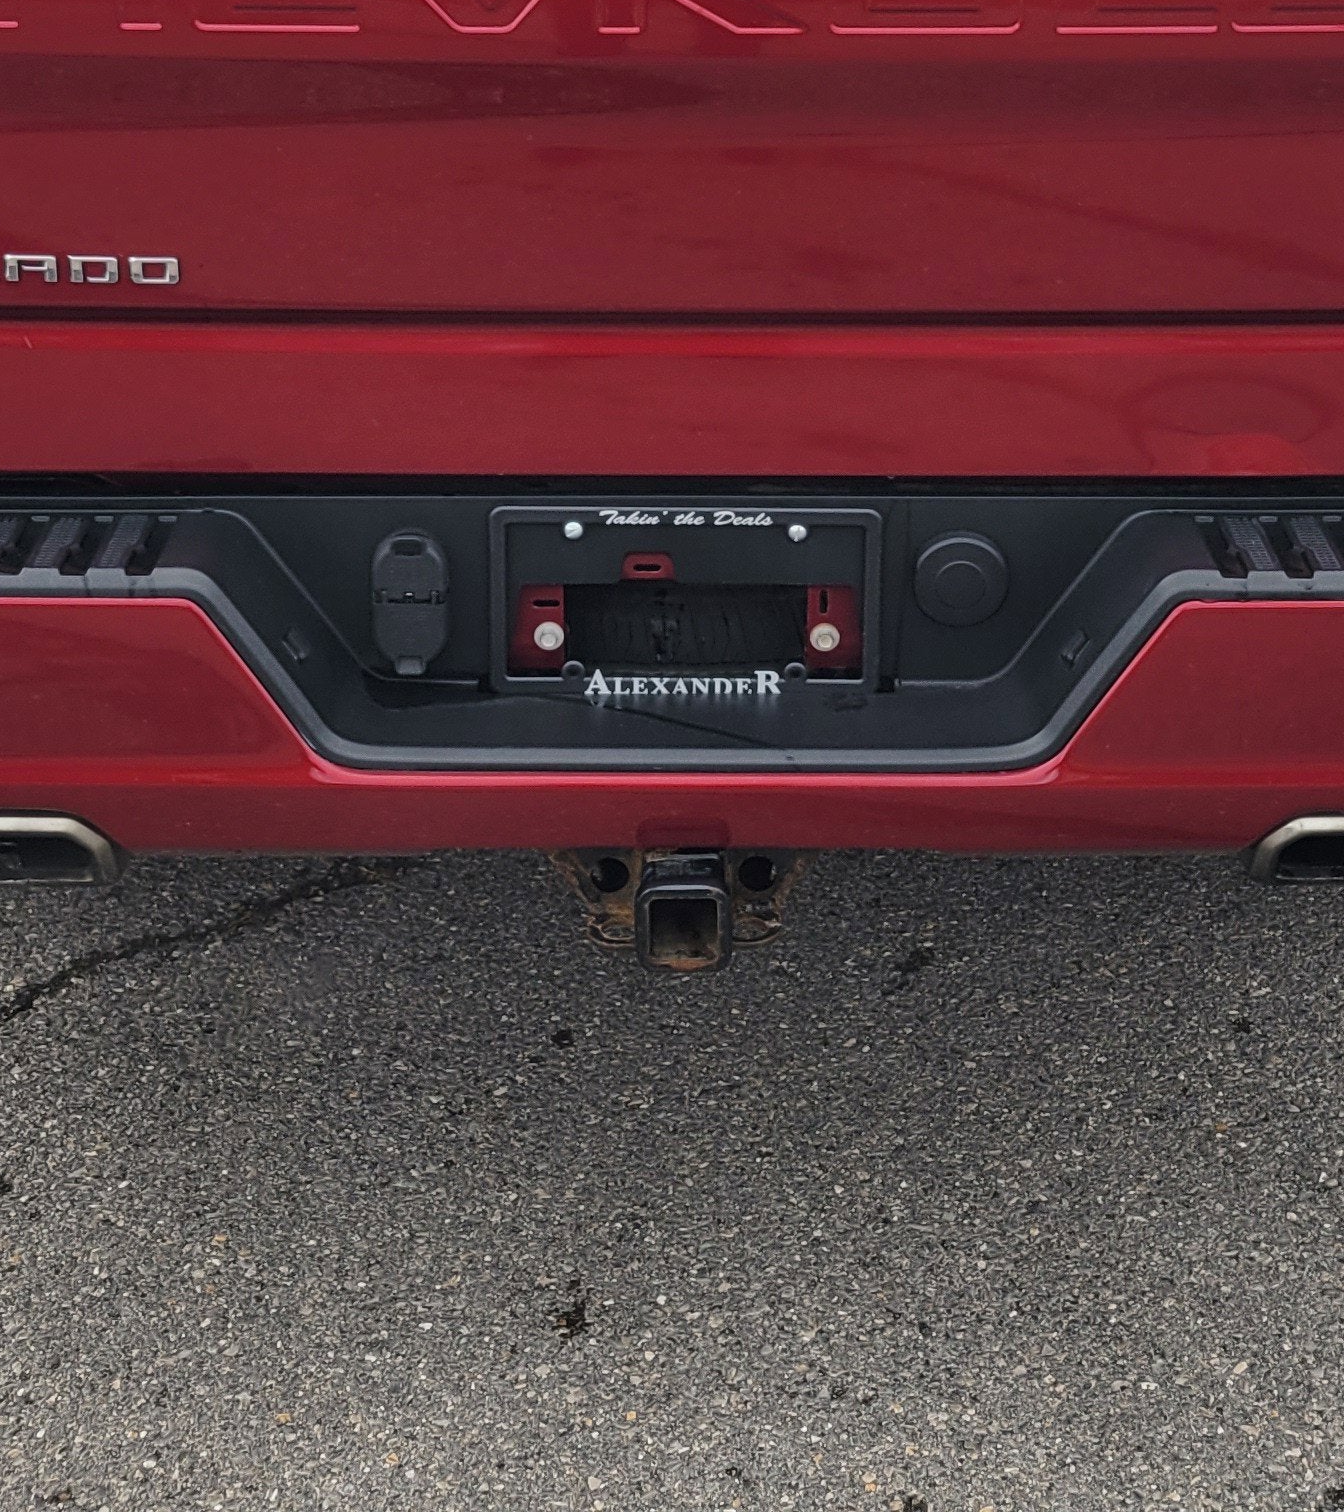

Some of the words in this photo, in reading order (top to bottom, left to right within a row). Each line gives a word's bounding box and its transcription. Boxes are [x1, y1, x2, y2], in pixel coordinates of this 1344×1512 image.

[598, 509, 669, 526] Takin'
[673, 511, 706, 526] the
[713, 510, 774, 526] Deals
